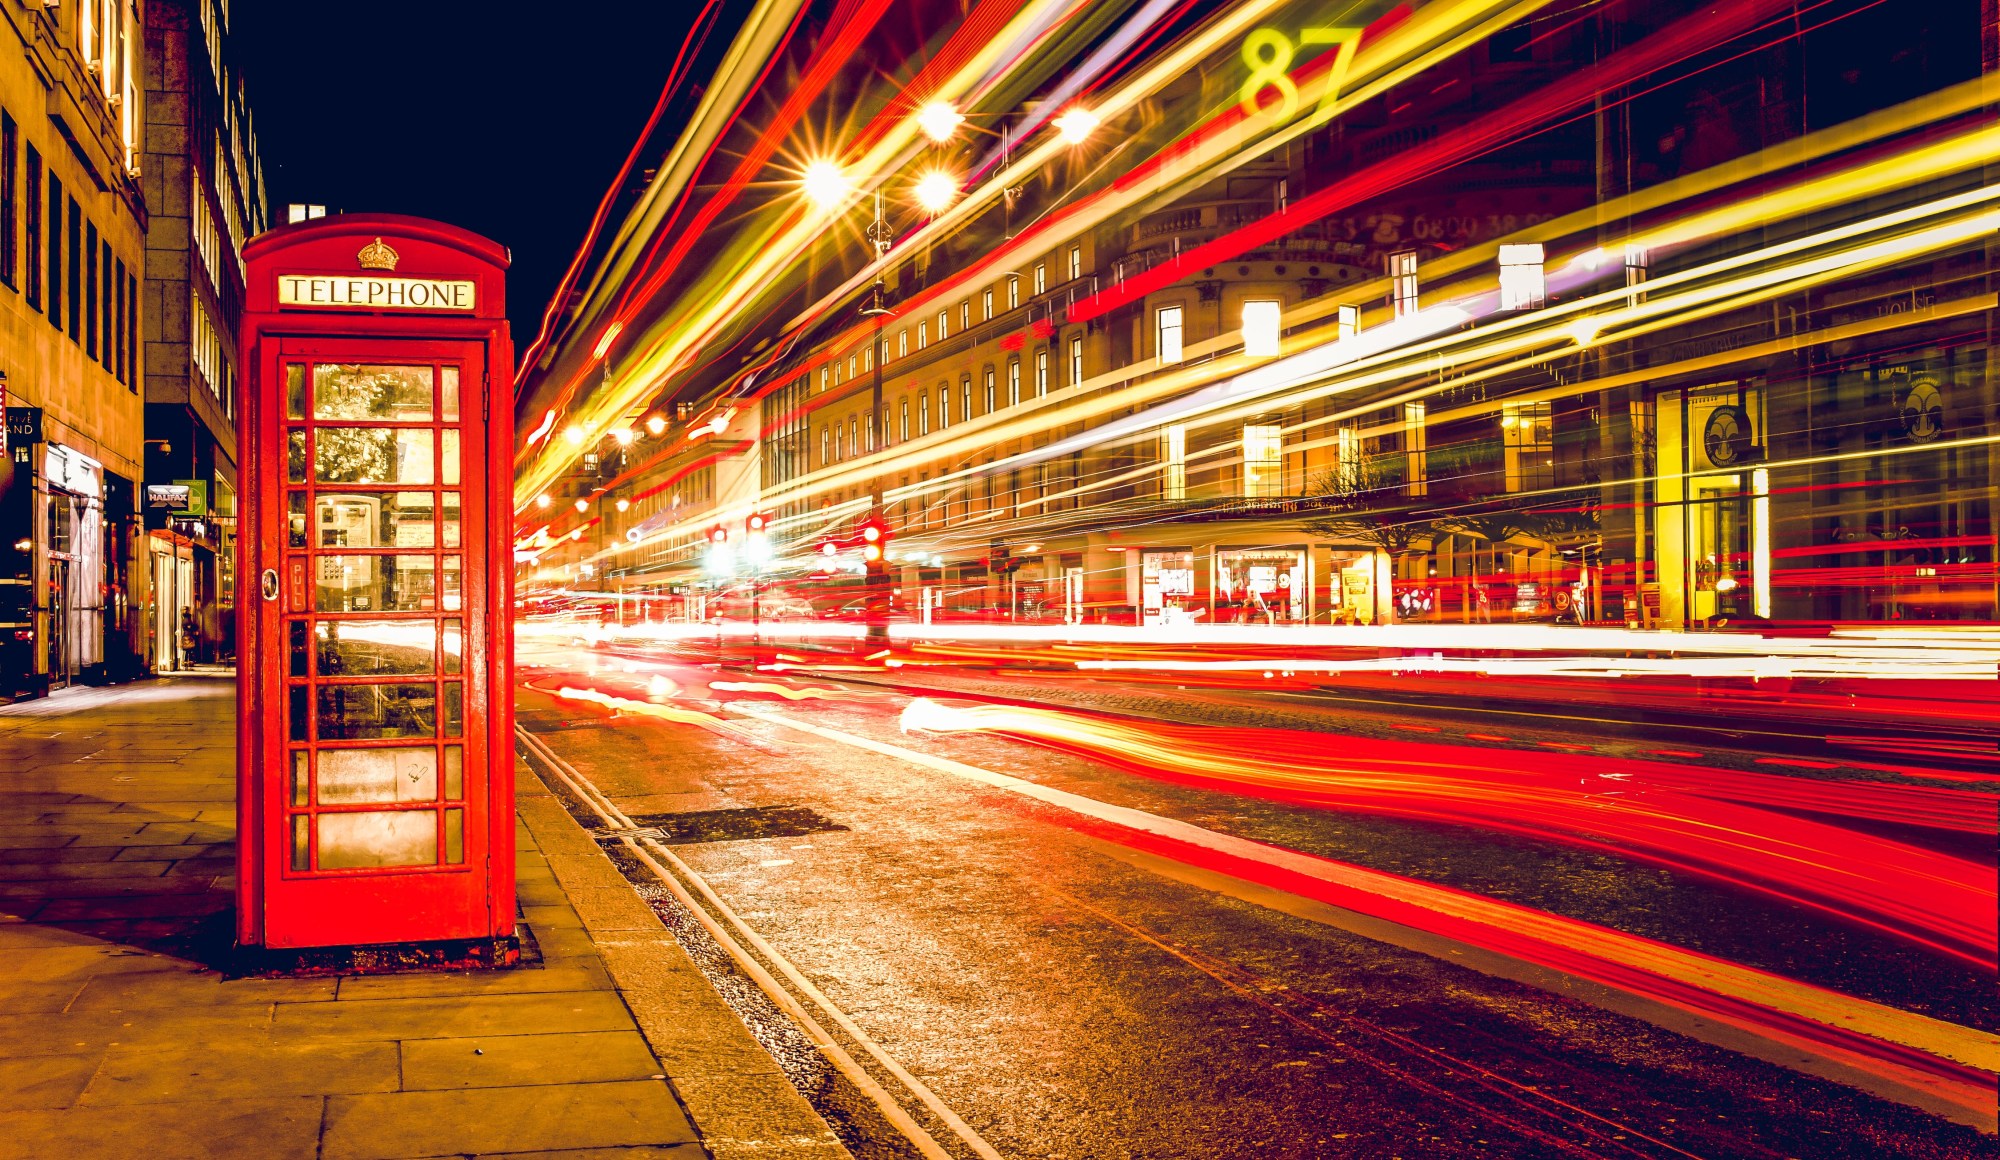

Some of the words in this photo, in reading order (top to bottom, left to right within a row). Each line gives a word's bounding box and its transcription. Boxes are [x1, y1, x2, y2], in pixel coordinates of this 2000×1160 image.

[1239, 27, 1367, 129] 87
[286, 278, 468, 307] TELEPHONE
[1906, 428, 1943, 443] INFORMATION
[1711, 453, 1738, 466] INFORMATION
[149, 494, 188, 502] HALIFAX
[294, 564, 302, 606] PULL
